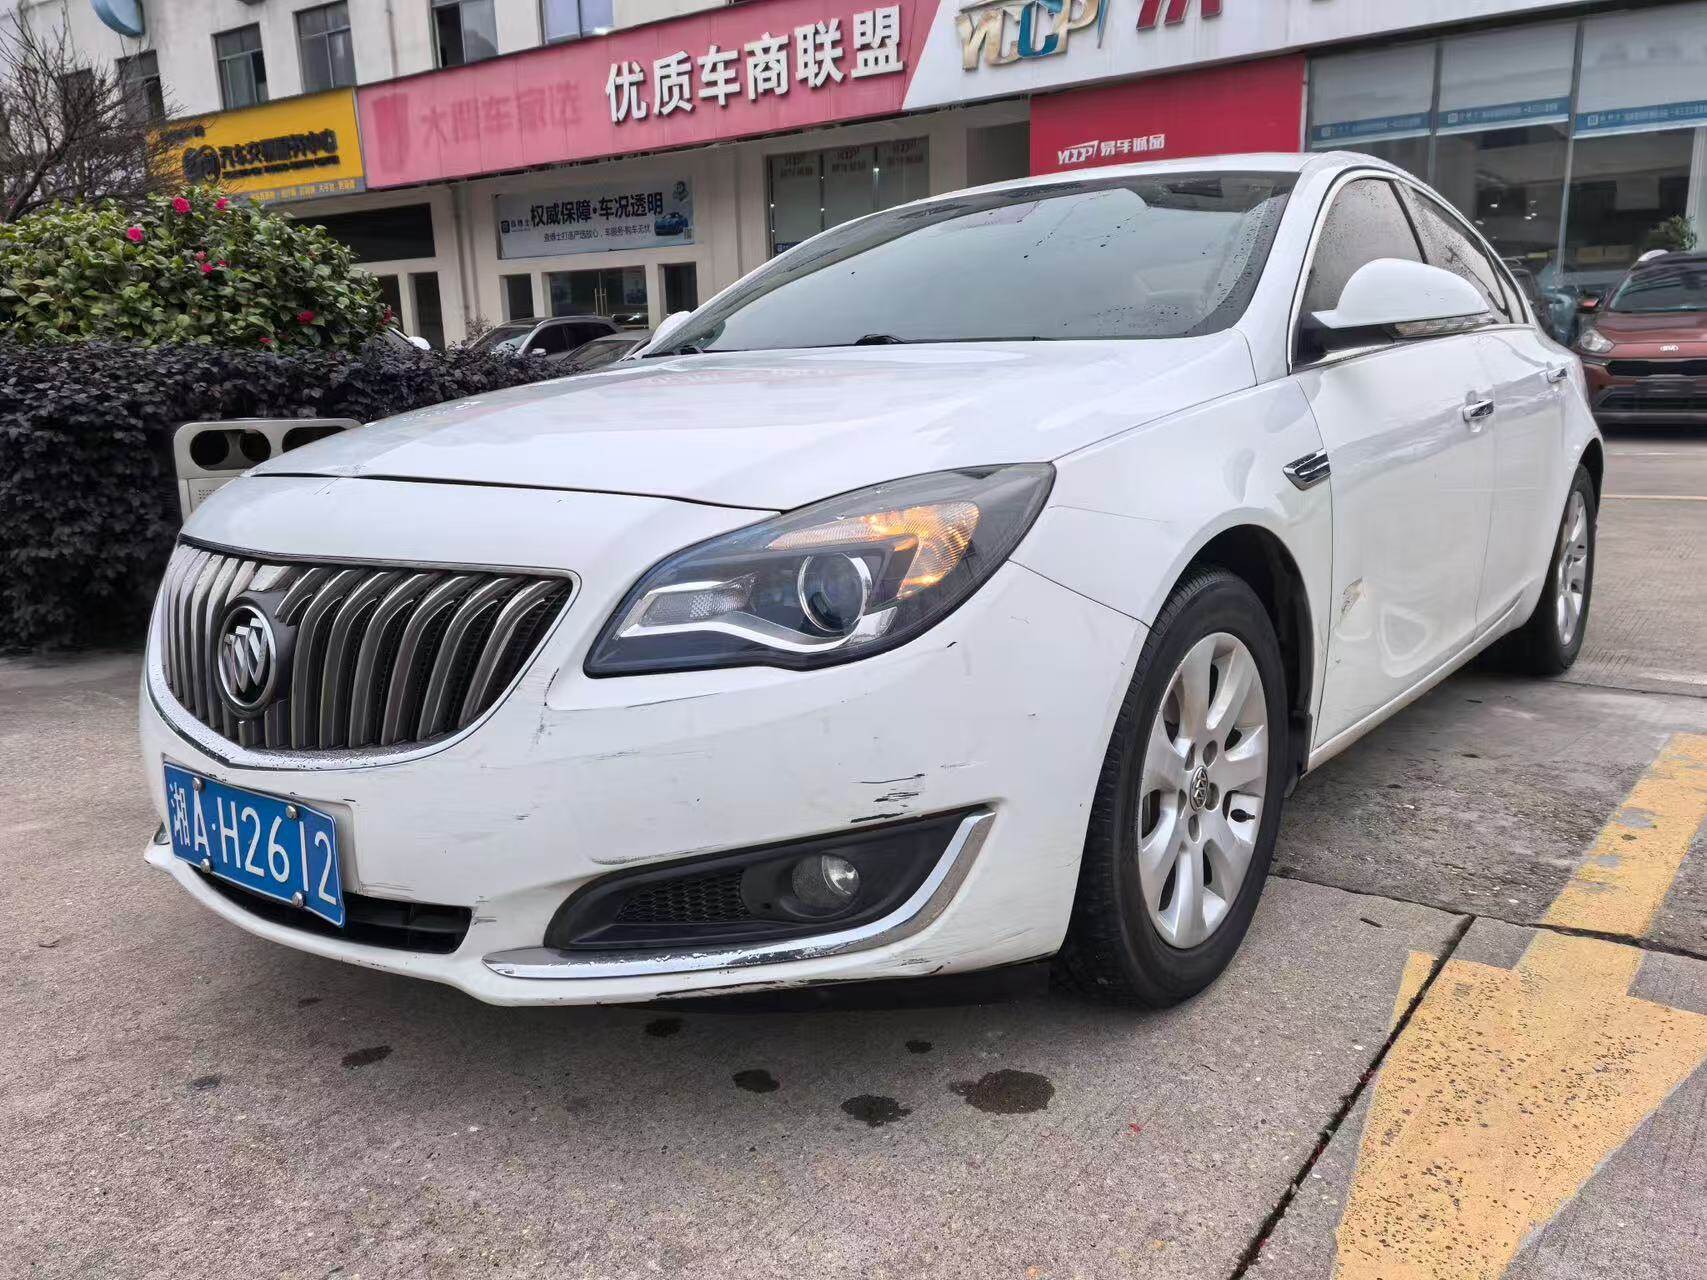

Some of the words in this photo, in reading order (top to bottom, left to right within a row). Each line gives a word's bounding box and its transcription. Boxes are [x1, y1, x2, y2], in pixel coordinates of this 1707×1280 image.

[605, 5, 903, 122] 优质车商联盟
[530, 192, 663, 228] 权威保障·车况透明
[169, 782, 337, 906] 湘A·H2612
